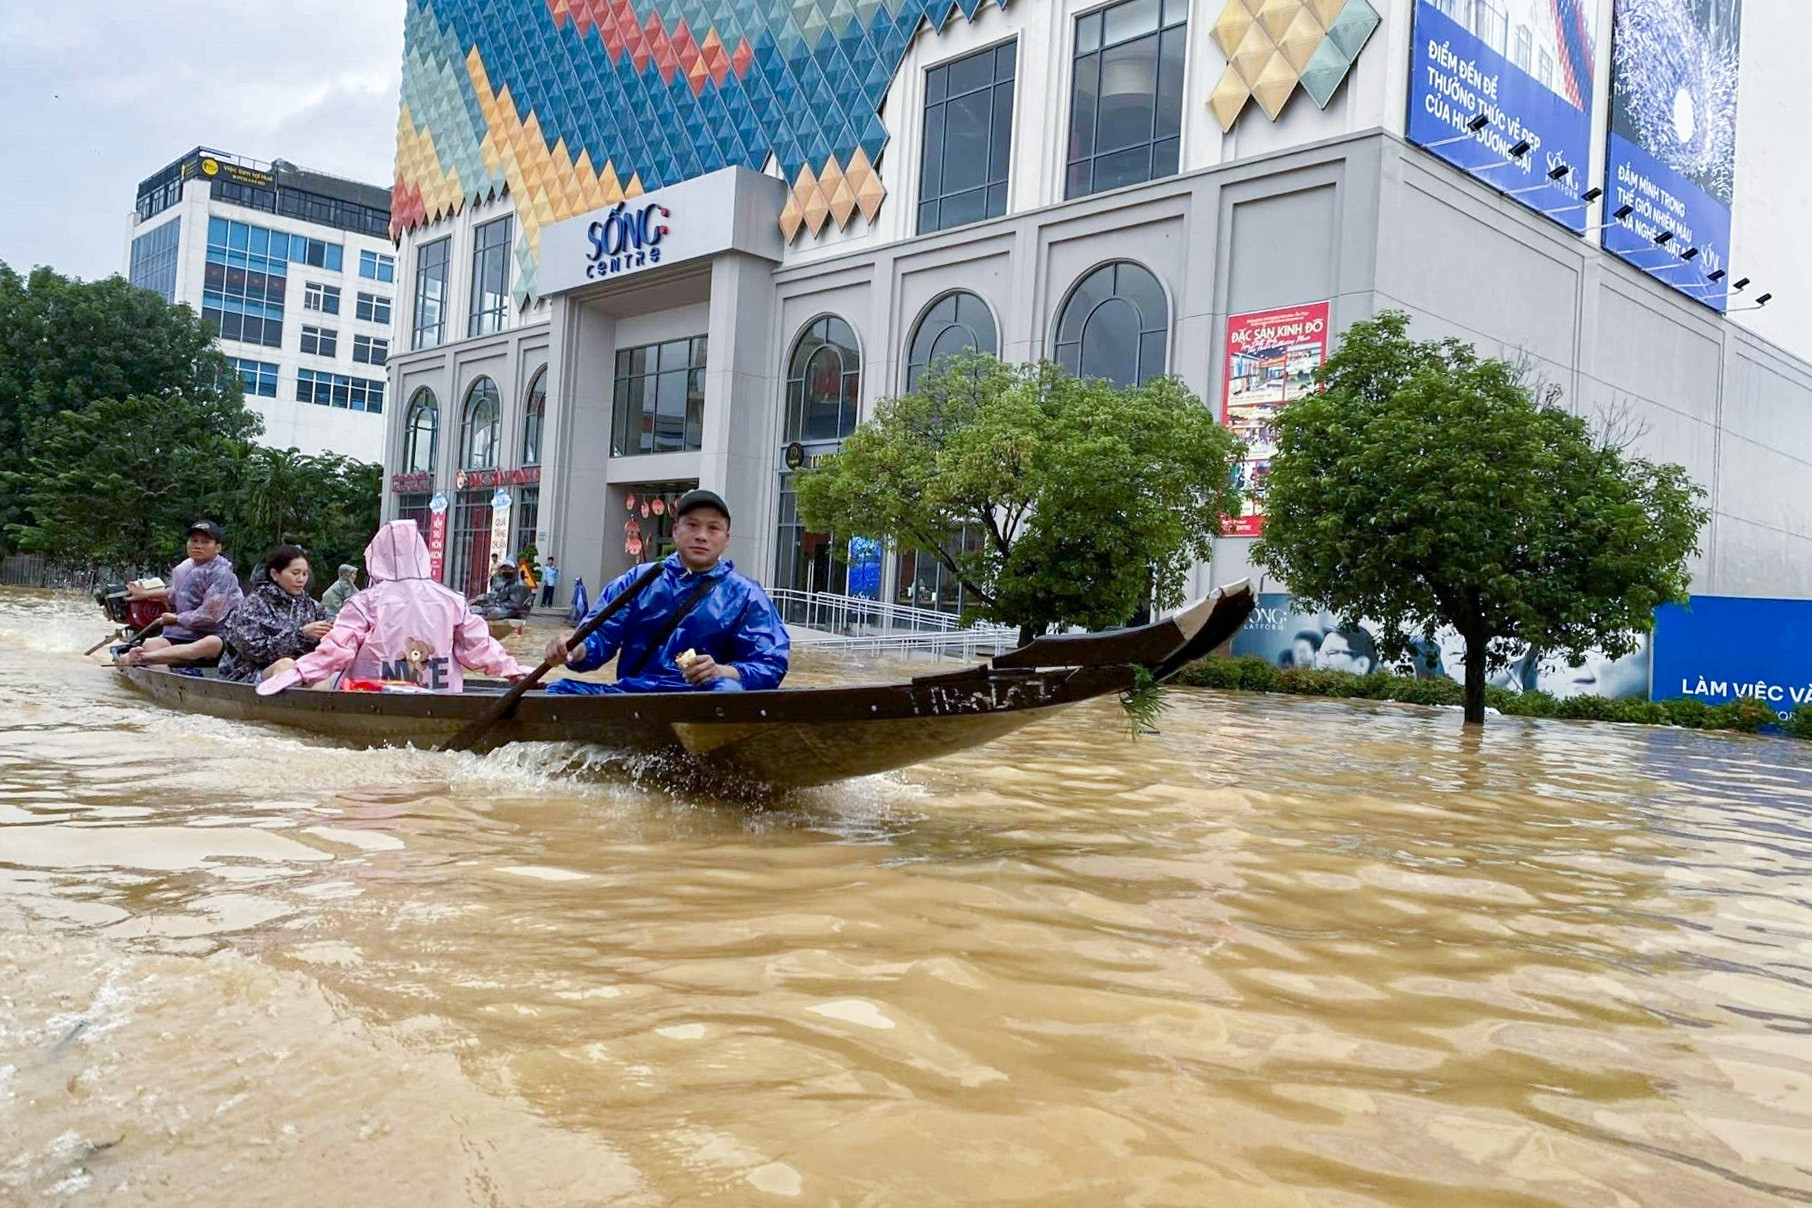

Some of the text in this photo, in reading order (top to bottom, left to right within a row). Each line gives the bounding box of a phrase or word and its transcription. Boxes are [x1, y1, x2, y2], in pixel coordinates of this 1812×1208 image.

[1428, 39, 1498, 100] ĐIỂM ĐẾN ĐỂ
[1425, 93, 1451, 124] CỦA
[1427, 66, 1476, 111] THƯỞNG
[1478, 98, 1506, 131] THỨC
[1508, 117, 1521, 140] VẺ
[1617, 187, 1635, 208] THẾ
[1635, 197, 1652, 218] GIỚI
[1618, 161, 1639, 188] ĐẮM
[1661, 189, 1685, 217] TRONG
[586, 201, 669, 262] SỐNG
[1231, 328, 1253, 344] ĐẶC
[1254, 323, 1275, 339] SẢN
[1277, 323, 1302, 338] KINH
[1305, 318, 1324, 334] ĐÔ
[1243, 623, 1284, 631] LATFORM
[1249, 602, 1287, 625] ỐNG
[1682, 675, 1727, 697] LÀM
